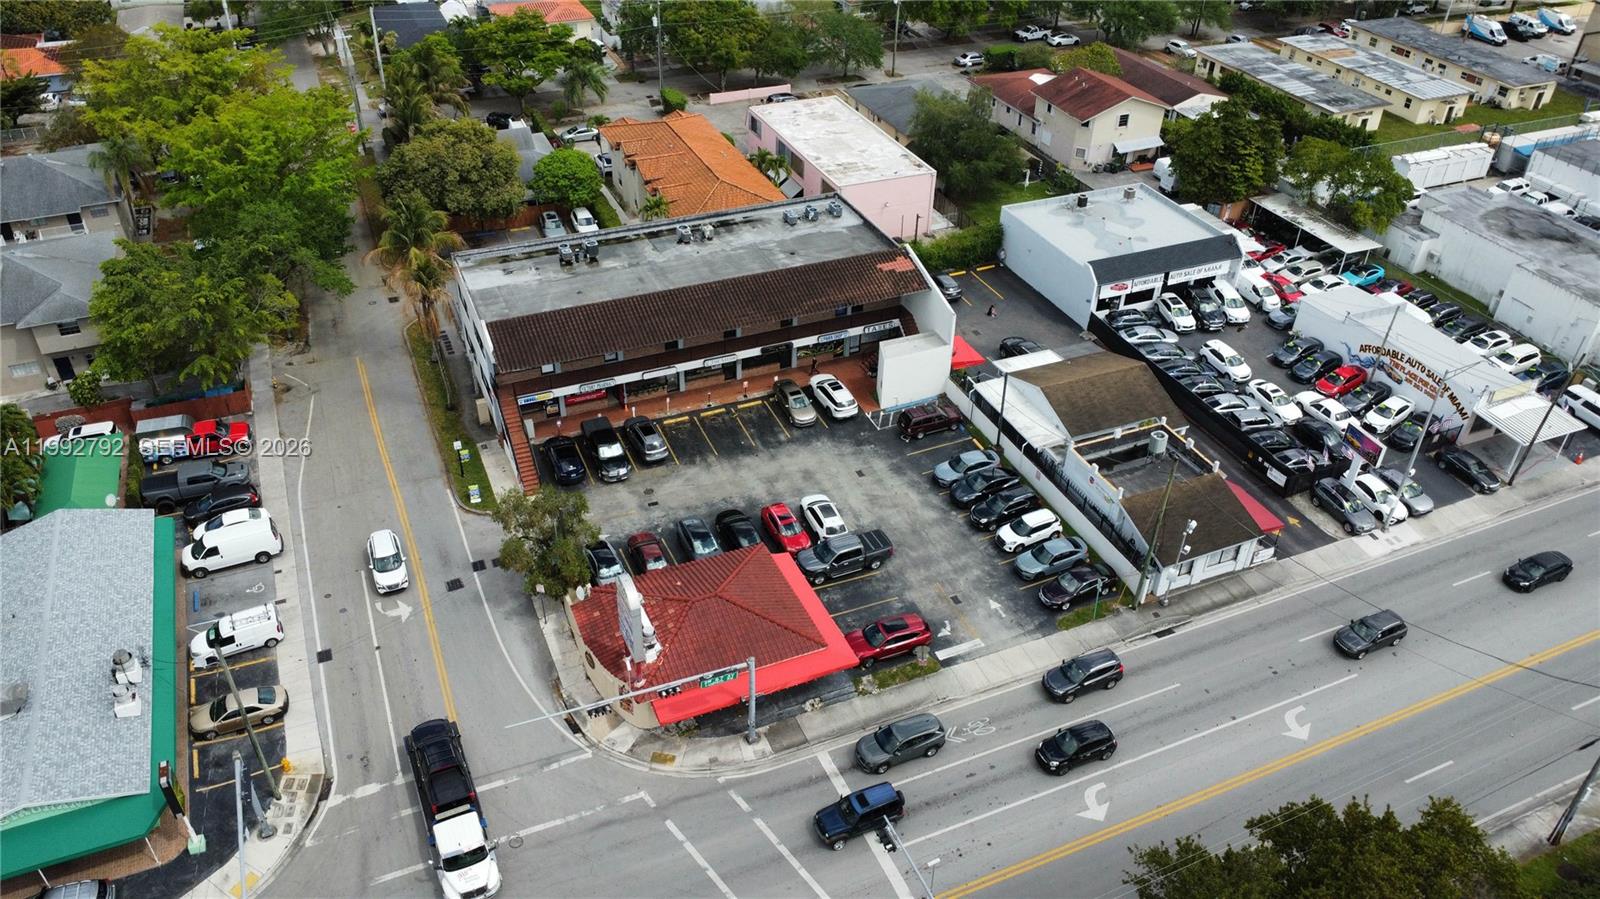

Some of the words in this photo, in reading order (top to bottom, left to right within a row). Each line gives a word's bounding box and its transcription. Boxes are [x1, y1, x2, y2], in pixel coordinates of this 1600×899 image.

[1133, 276, 1164, 287] AFFORDABLE
[1359, 344, 1406, 362] AFFORDABLE
[1405, 356, 1427, 374] AUTO
[1425, 369, 1444, 386] SALE
[1447, 391, 1470, 421] MIAMI
